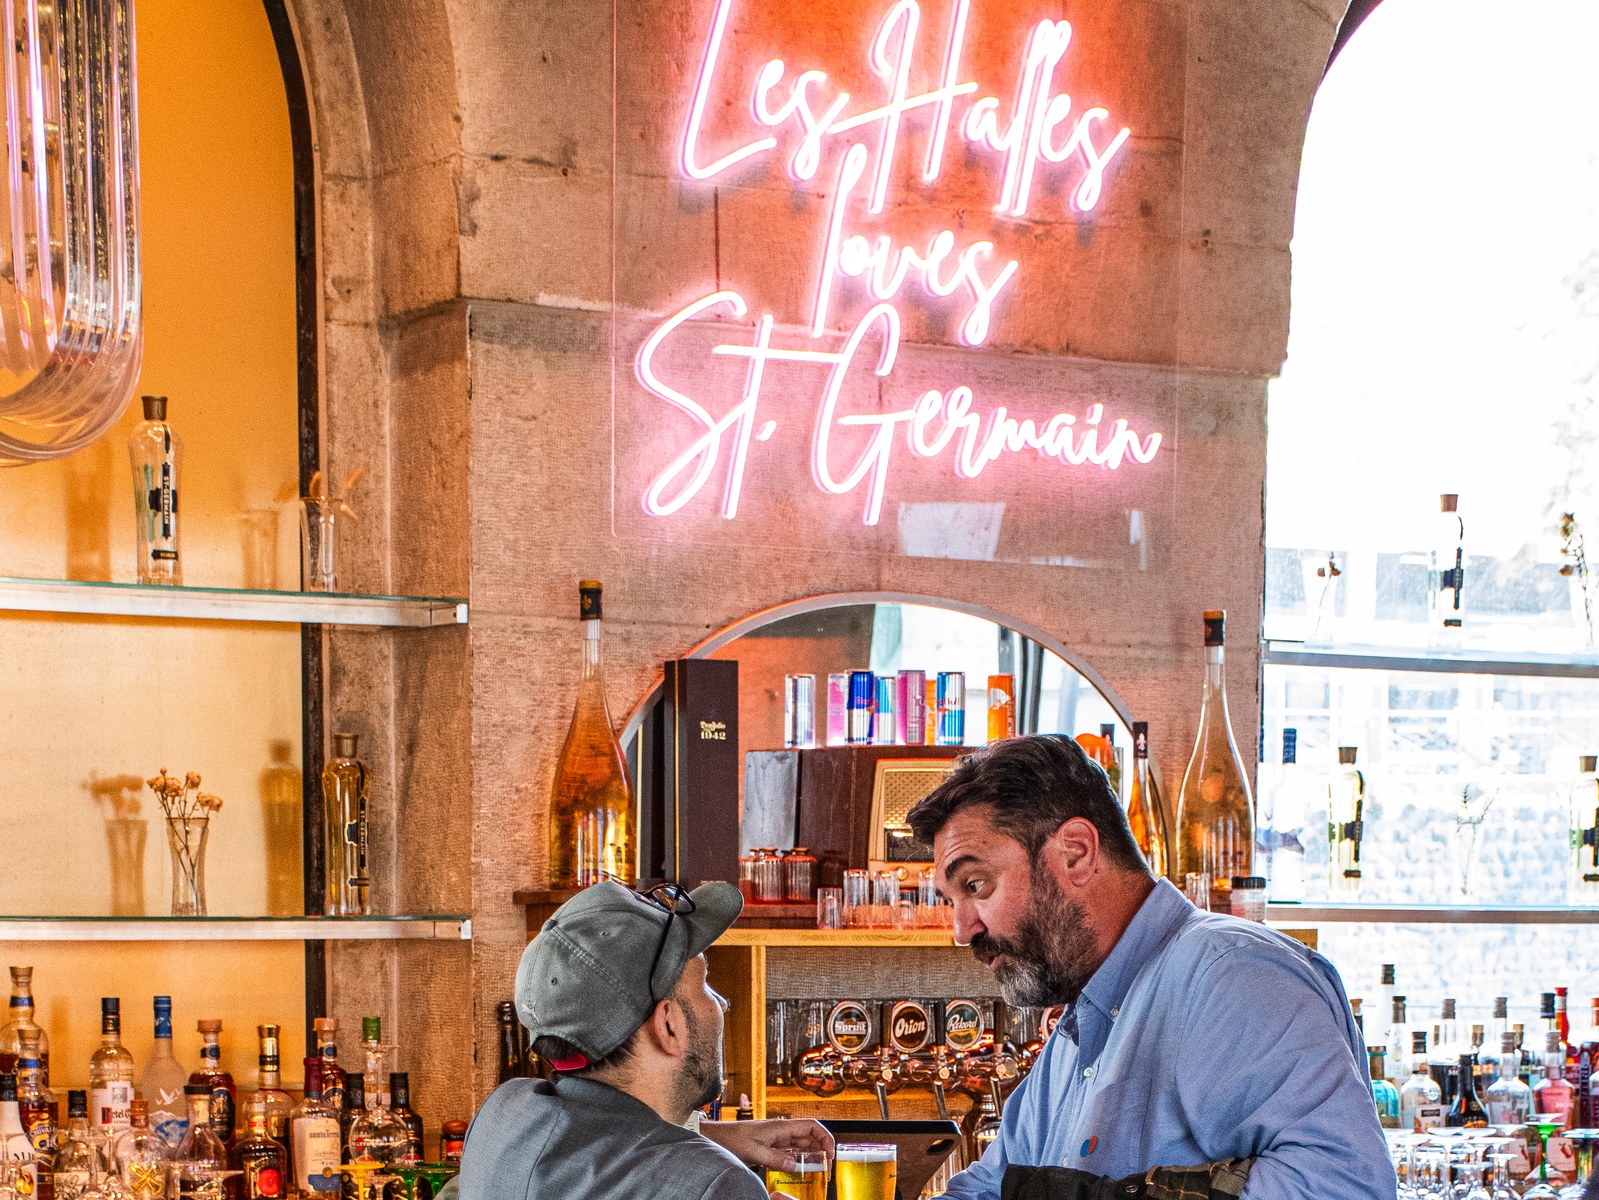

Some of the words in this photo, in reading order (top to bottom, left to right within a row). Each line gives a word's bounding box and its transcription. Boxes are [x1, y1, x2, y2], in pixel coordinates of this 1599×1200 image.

[680, 0, 850, 180] Les
[829, 0, 1131, 217] Halles
[811, 303, 1164, 527] Germain
[700, 731, 726, 740] 1942
[835, 1021, 867, 1034] Sprint
[895, 1017, 926, 1038] Orion
[946, 1013, 978, 1032] Rekord
